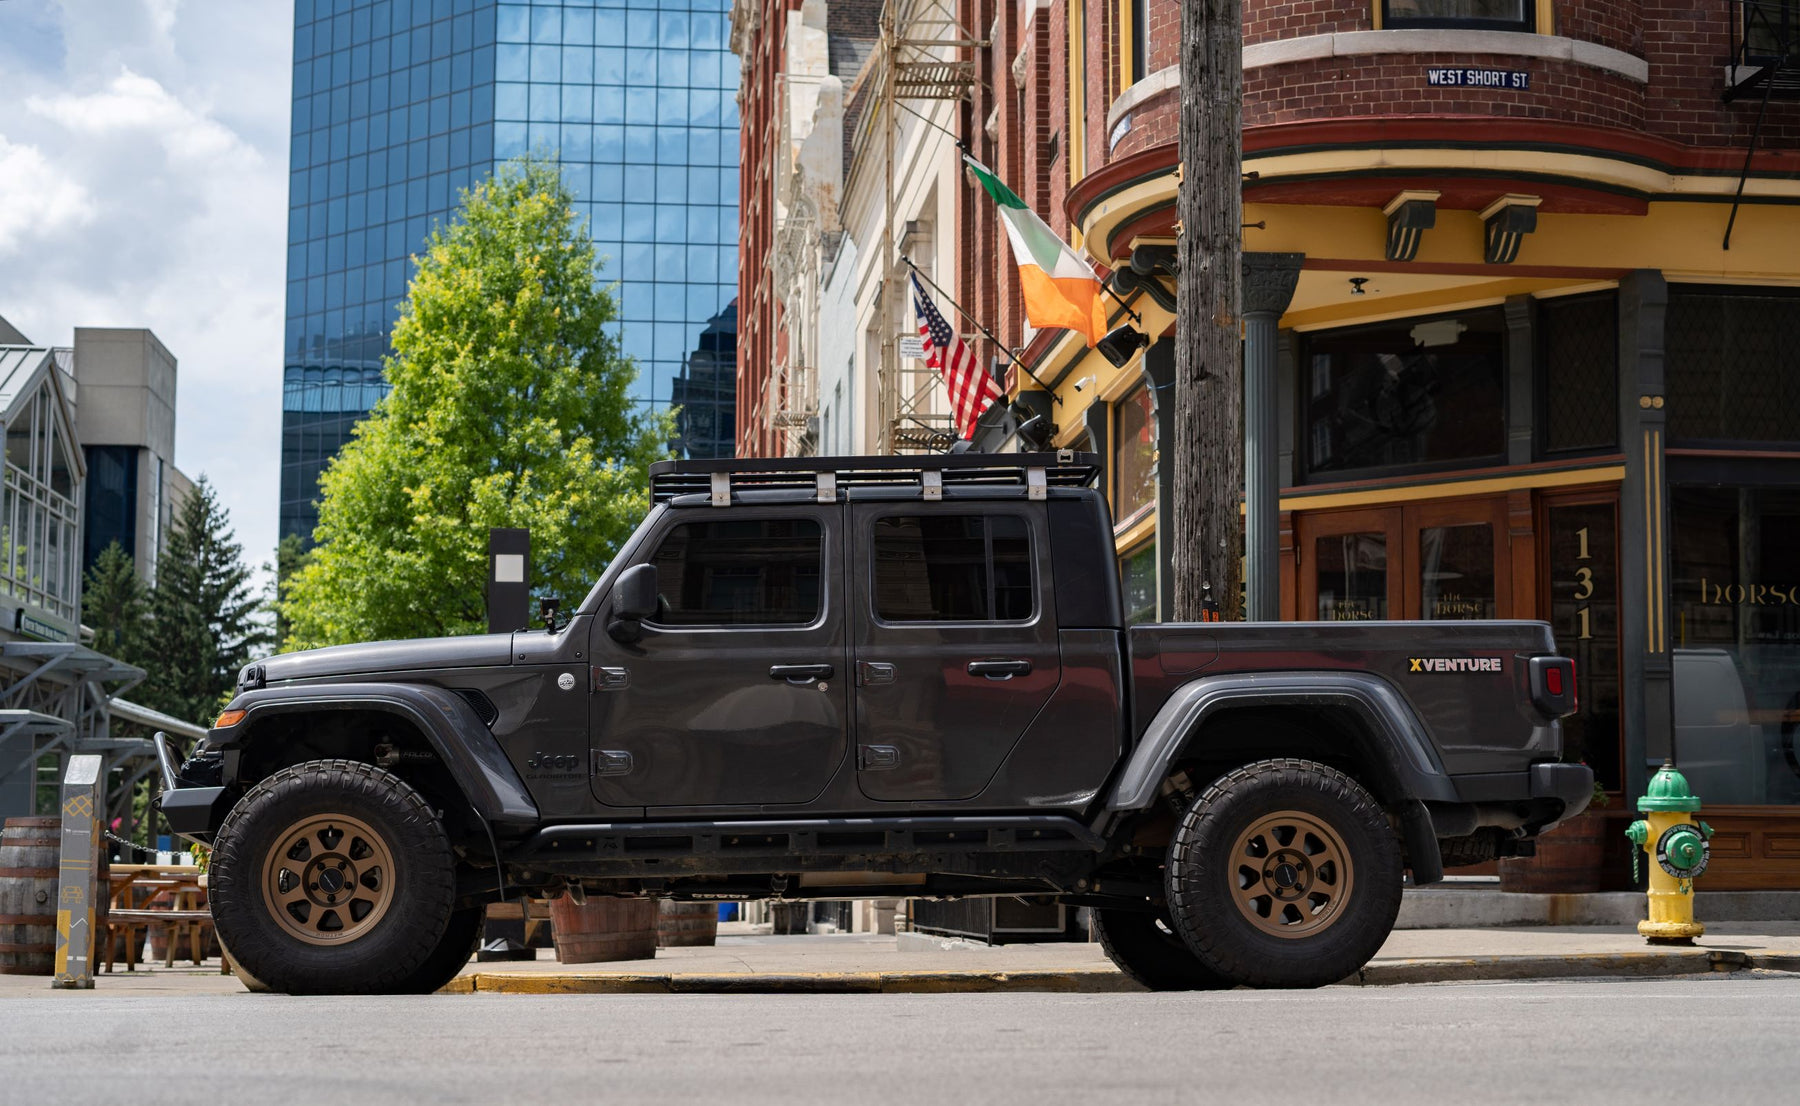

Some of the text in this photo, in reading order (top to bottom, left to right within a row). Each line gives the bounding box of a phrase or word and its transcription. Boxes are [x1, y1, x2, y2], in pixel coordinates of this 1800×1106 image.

[1428, 69, 1463, 84] WEST
[1467, 70, 1507, 86] SHORT
[1410, 658, 1502, 671] XVENTURE
[527, 751, 580, 772] Jeep
